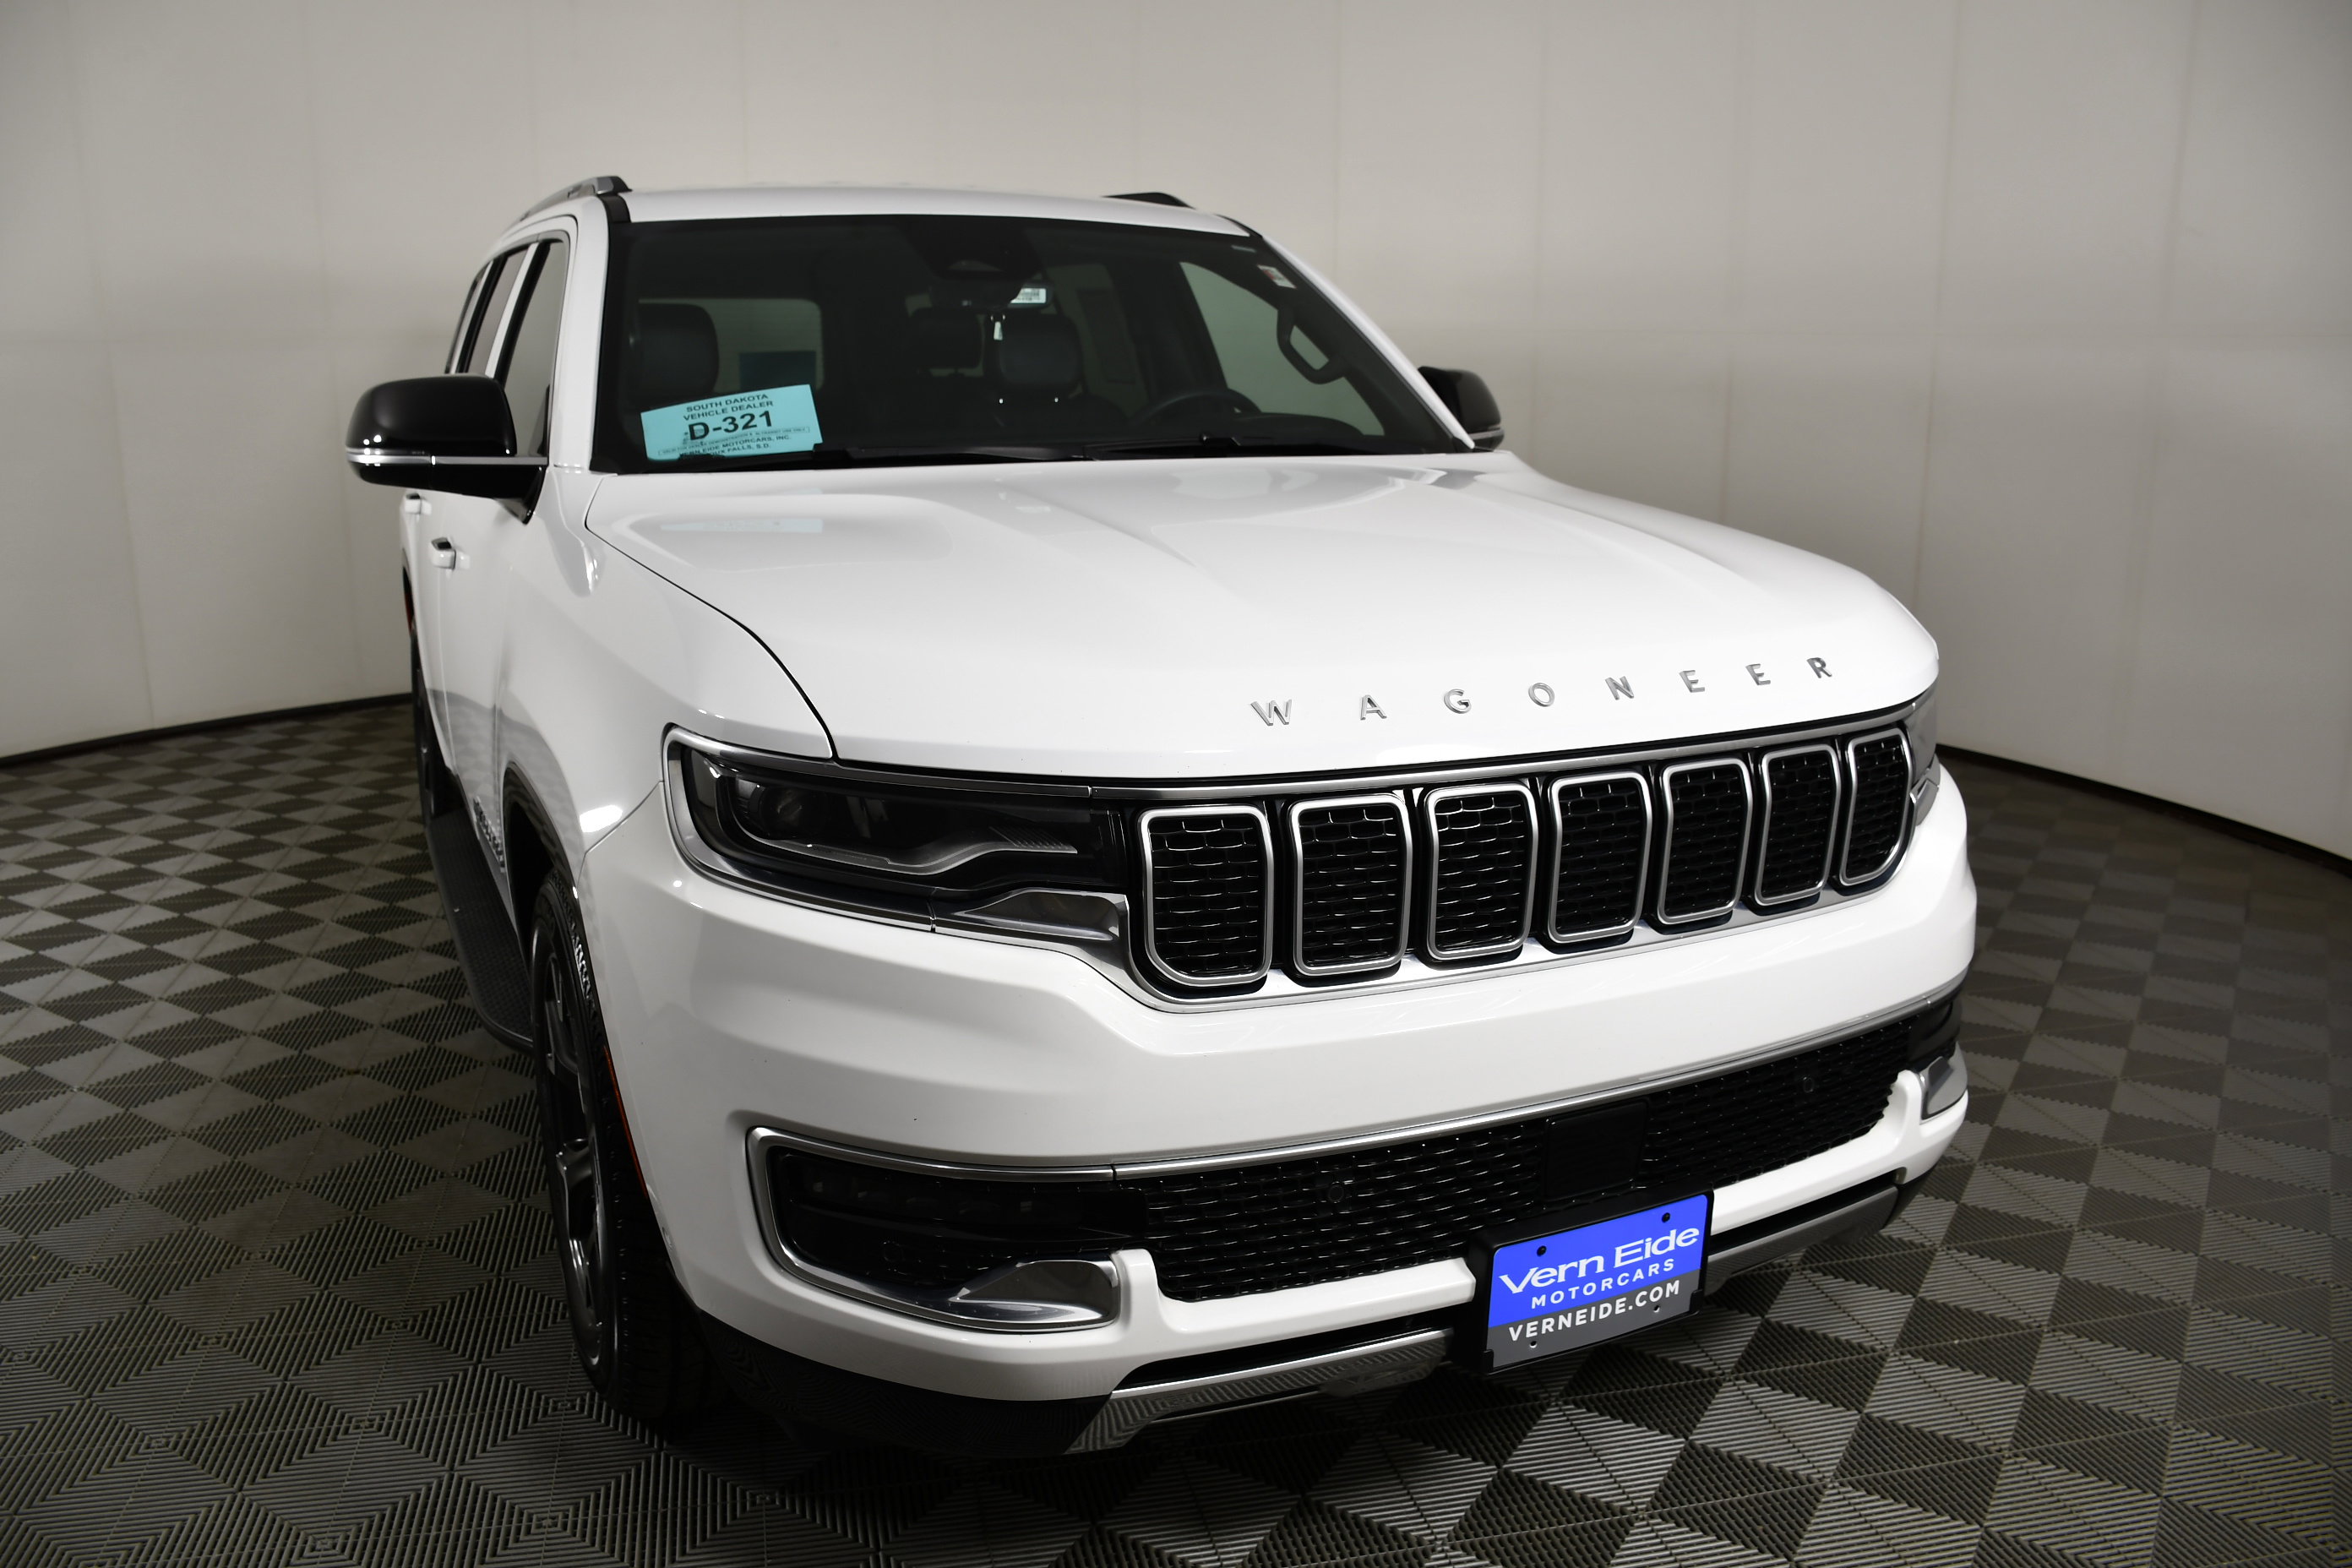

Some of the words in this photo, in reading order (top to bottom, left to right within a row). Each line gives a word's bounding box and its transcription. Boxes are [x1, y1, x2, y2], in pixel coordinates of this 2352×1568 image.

[683, 407, 729, 421] VEHICLE
[731, 400, 774, 412] DEALER
[686, 400, 722, 413] SOUTH
[725, 394, 769, 406] DAKOTA
[688, 411, 772, 441] D-321
[1250, 656, 1832, 727] WAGONEER
[1499, 1255, 1604, 1294] Vern
[1614, 1228, 1700, 1268] Eide
[1531, 1258, 1674, 1309] MOTORCARS
[1508, 1280, 1680, 1342] VERNEIDE.COM
